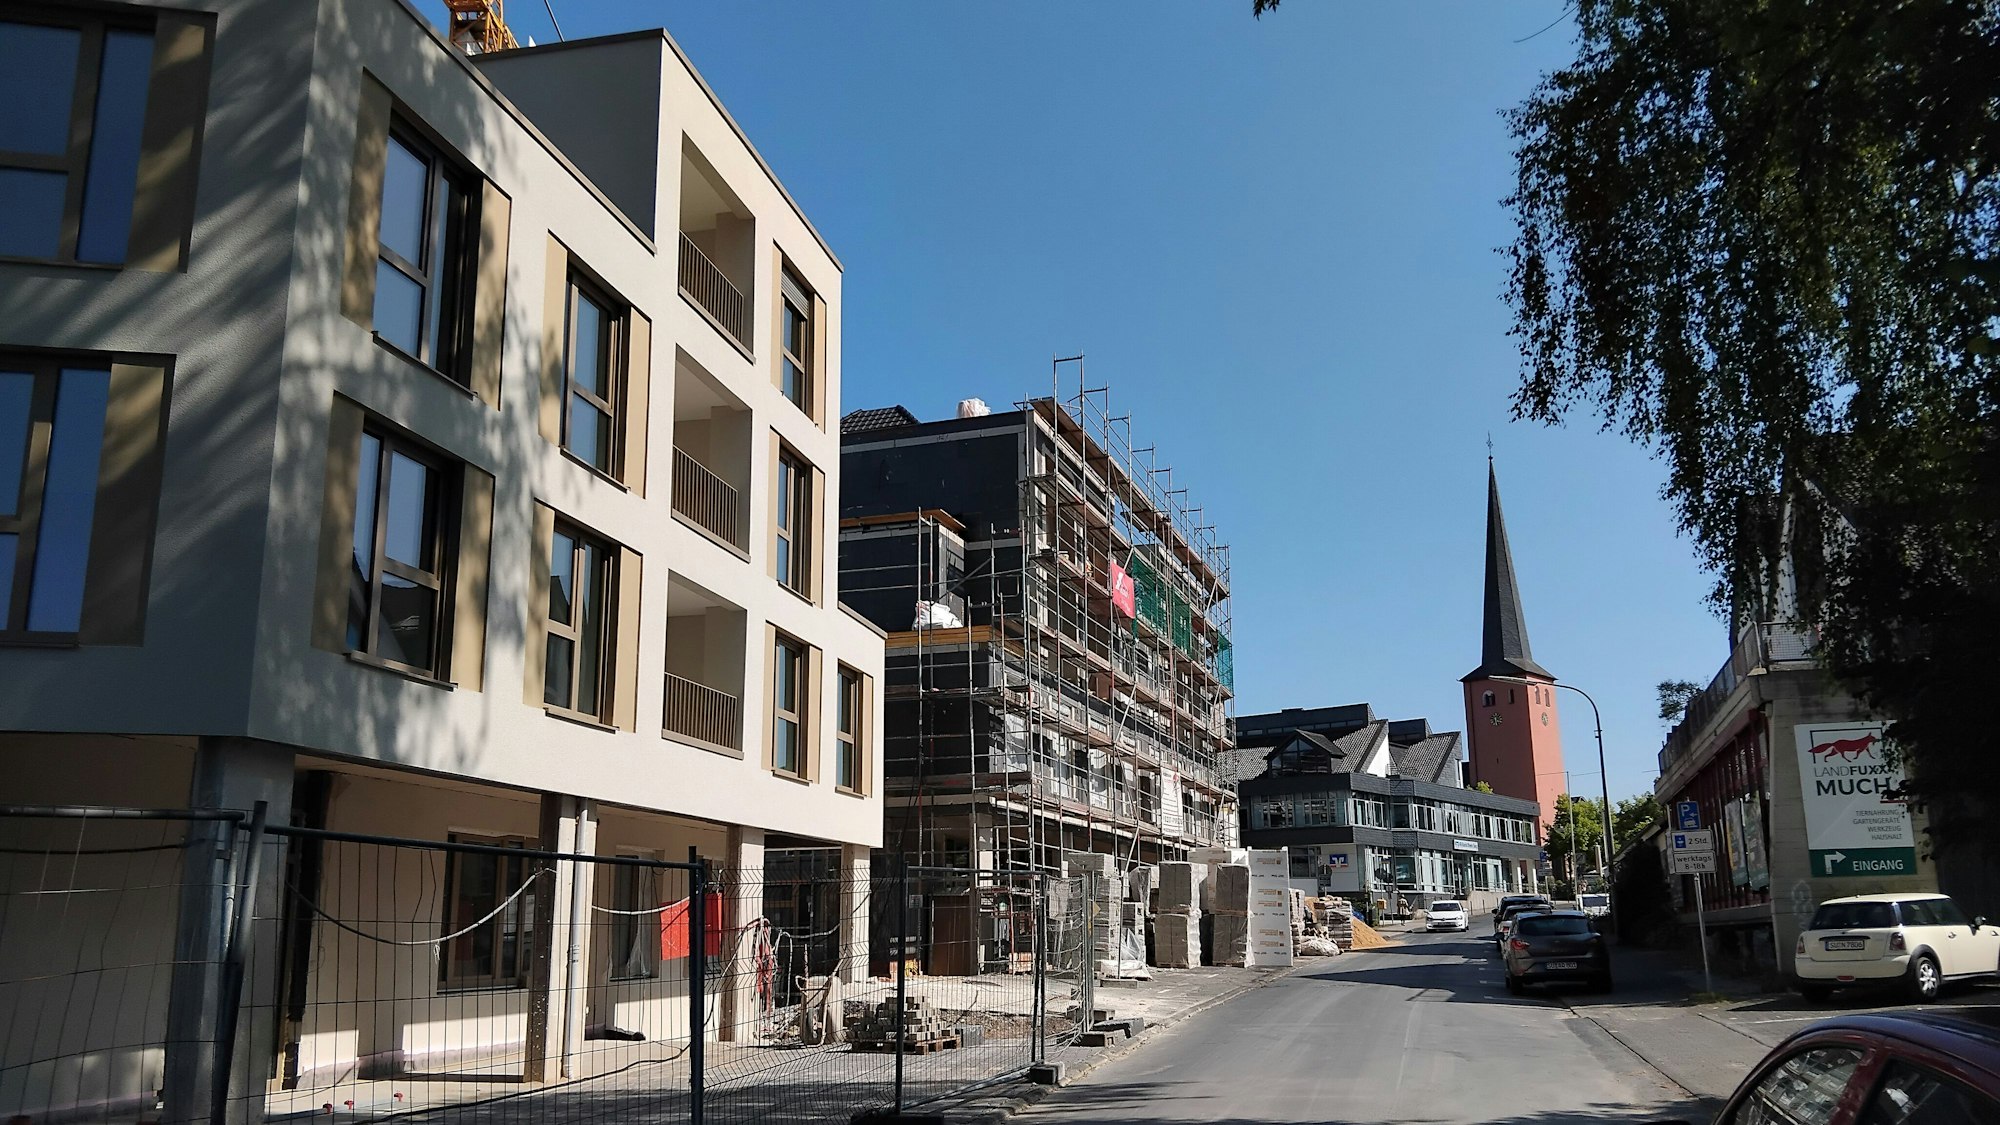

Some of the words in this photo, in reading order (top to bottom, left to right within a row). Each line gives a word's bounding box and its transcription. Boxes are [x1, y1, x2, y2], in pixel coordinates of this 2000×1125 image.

[1814, 765, 1889, 778] LANDFUXX
[1816, 778, 1891, 796] MUCH
[1681, 804, 1690, 817] P
[1867, 825, 1902, 833] WERKZEUG
[1871, 833, 1903, 841] HAUSHALT
[1676, 855, 1712, 863] werktags
[1852, 860, 1904, 871] EINGANG
